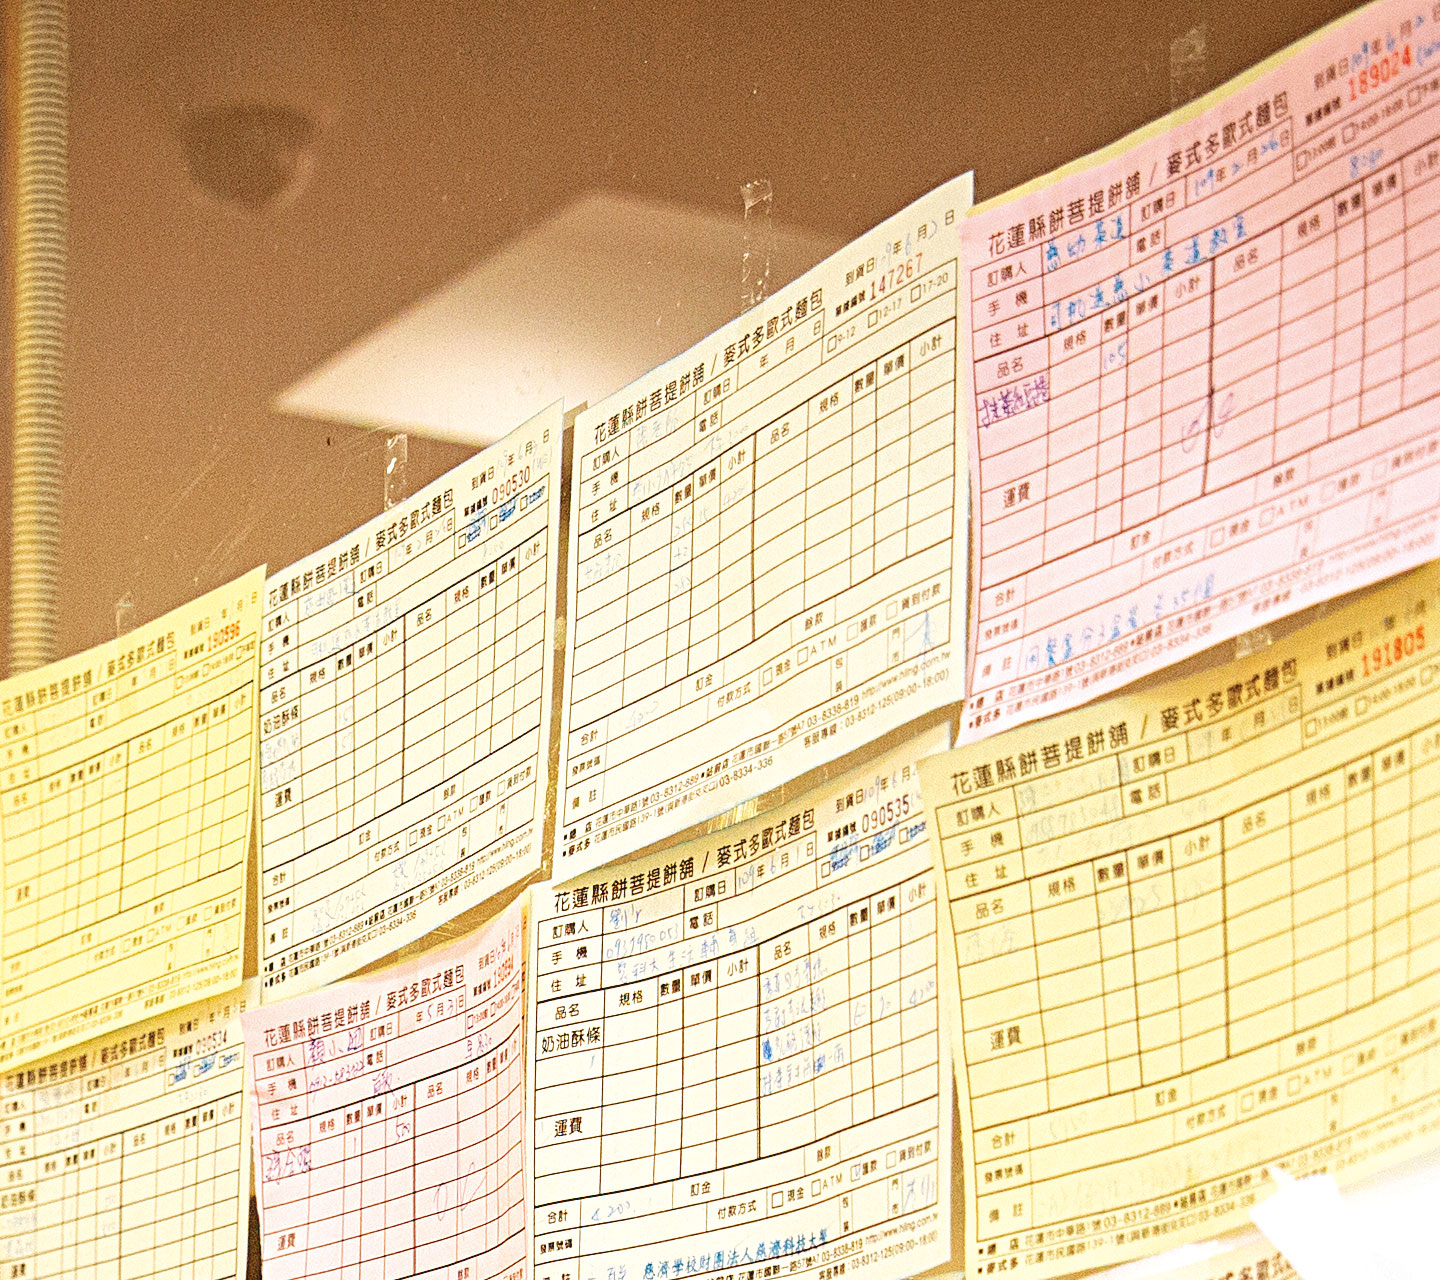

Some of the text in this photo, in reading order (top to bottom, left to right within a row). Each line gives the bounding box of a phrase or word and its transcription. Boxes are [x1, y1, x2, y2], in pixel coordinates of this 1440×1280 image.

[1348, 44, 1413, 101] 189024
[987, 94, 1290, 258] 花蓮縣餅菩提餅舖 麥式多歐式麵包
[869, 253, 923, 299] 147267
[594, 288, 823, 445] 花蓮縣餅菩提餅舖 麥式多歐式麵包
[492, 467, 531, 507] 090530
[1359, 625, 1427, 678] 191805
[950, 656, 1300, 797] 花蓮縣餅菩提餅舖 麥式多歐式麵包
[861, 795, 912, 834] 090535
[554, 806, 816, 912] 花蓮縣餅菩提餅舖 麥式多歐式麵包
[541, 1025, 601, 1054] 奶油酥條
